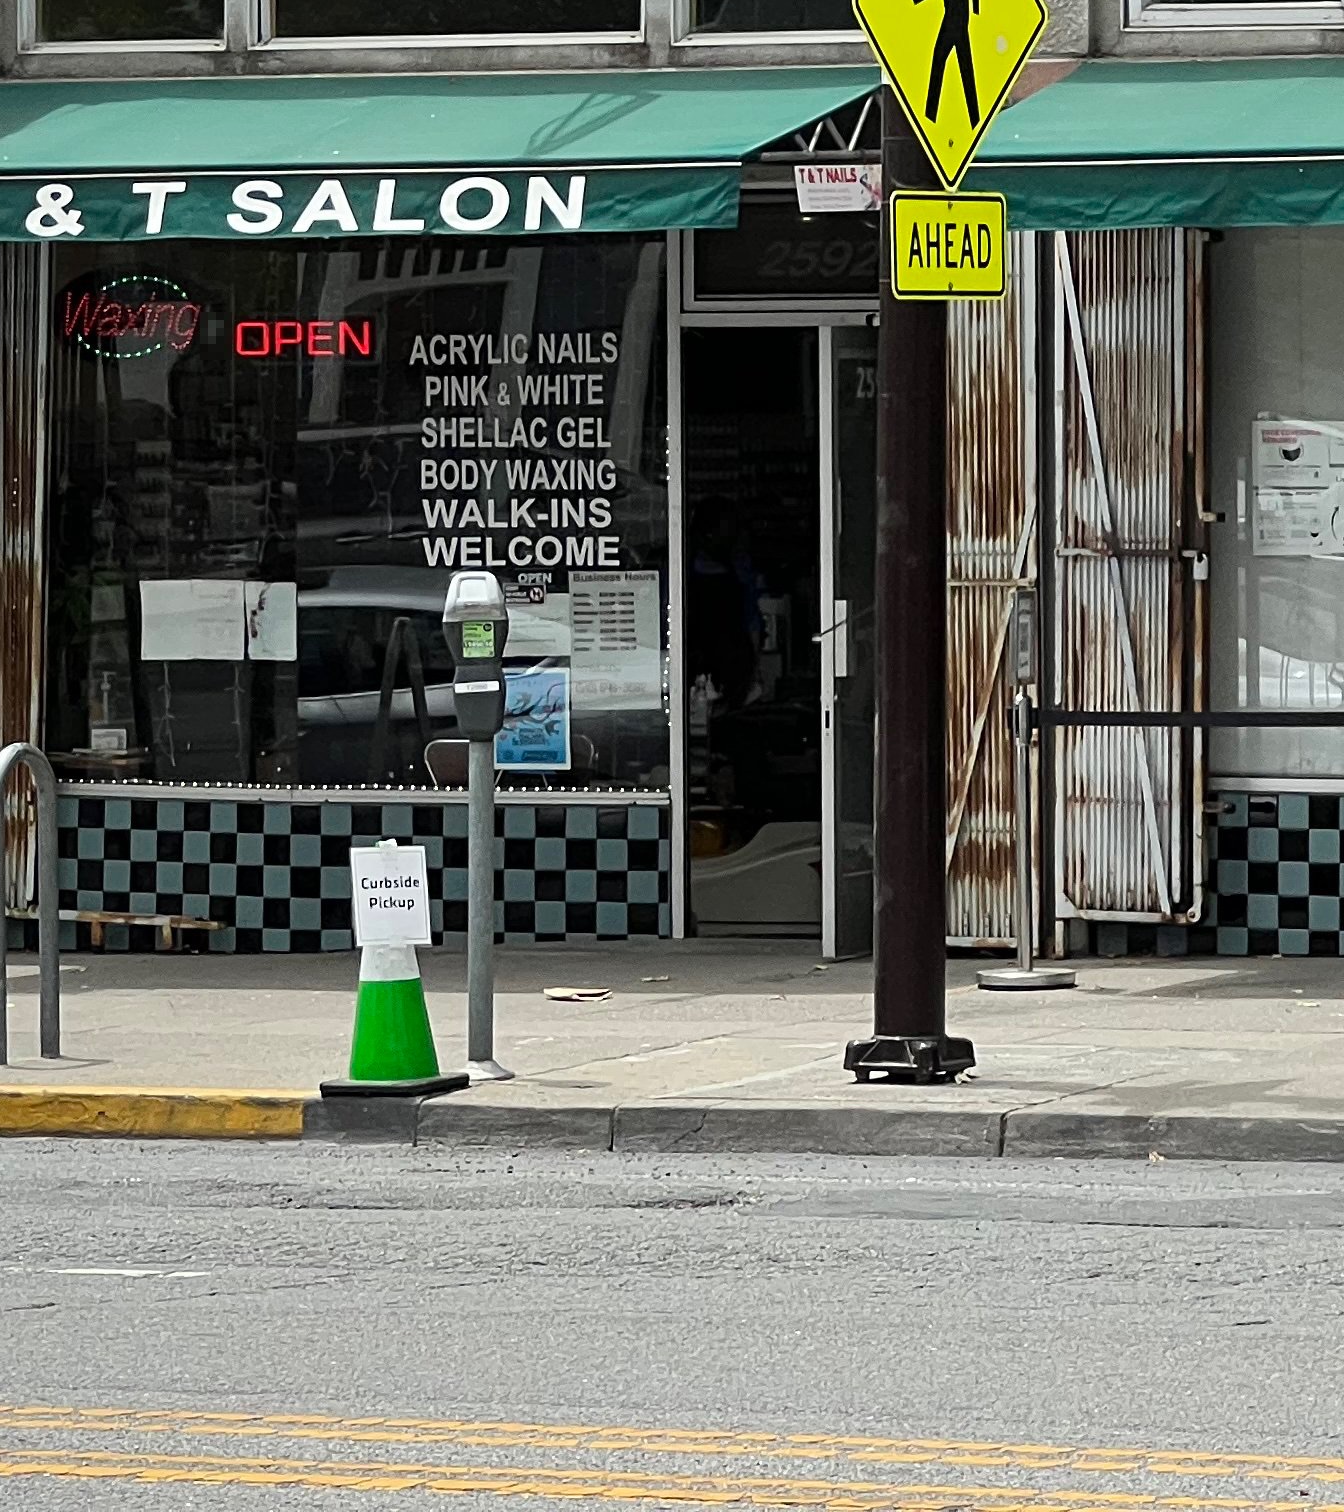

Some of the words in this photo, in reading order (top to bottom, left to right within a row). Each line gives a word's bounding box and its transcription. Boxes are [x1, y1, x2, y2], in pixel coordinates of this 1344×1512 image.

[826, 167, 857, 183] NAILS
[24, 185, 83, 238] &
[132, 180, 190, 234] T
[226, 175, 587, 234] SALON
[757, 240, 879, 278] 2592
[908, 222, 992, 269] AHEAD
[64, 291, 201, 350] Waxing
[236, 320, 371, 357] OPEN
[409, 333, 529, 366] ACRYLIC
[538, 331, 618, 364] NAILS
[425, 375, 489, 407] PINK
[497, 381, 512, 406] &
[517, 374, 604, 406] WHITE
[421, 416, 548, 449] SHELLAC
[557, 416, 612, 448] GEL
[420, 459, 498, 491] BODY
[505, 459, 617, 491] WAXING
[422, 497, 612, 529] WALK-INS
[422, 535, 621, 568] WELCOME
[518, 572, 553, 584] OPEN
[573, 573, 622, 583] Business
[624, 572, 657, 582] Hours
[361, 876, 420, 890] Curbside
[369, 896, 415, 911] Pickup
